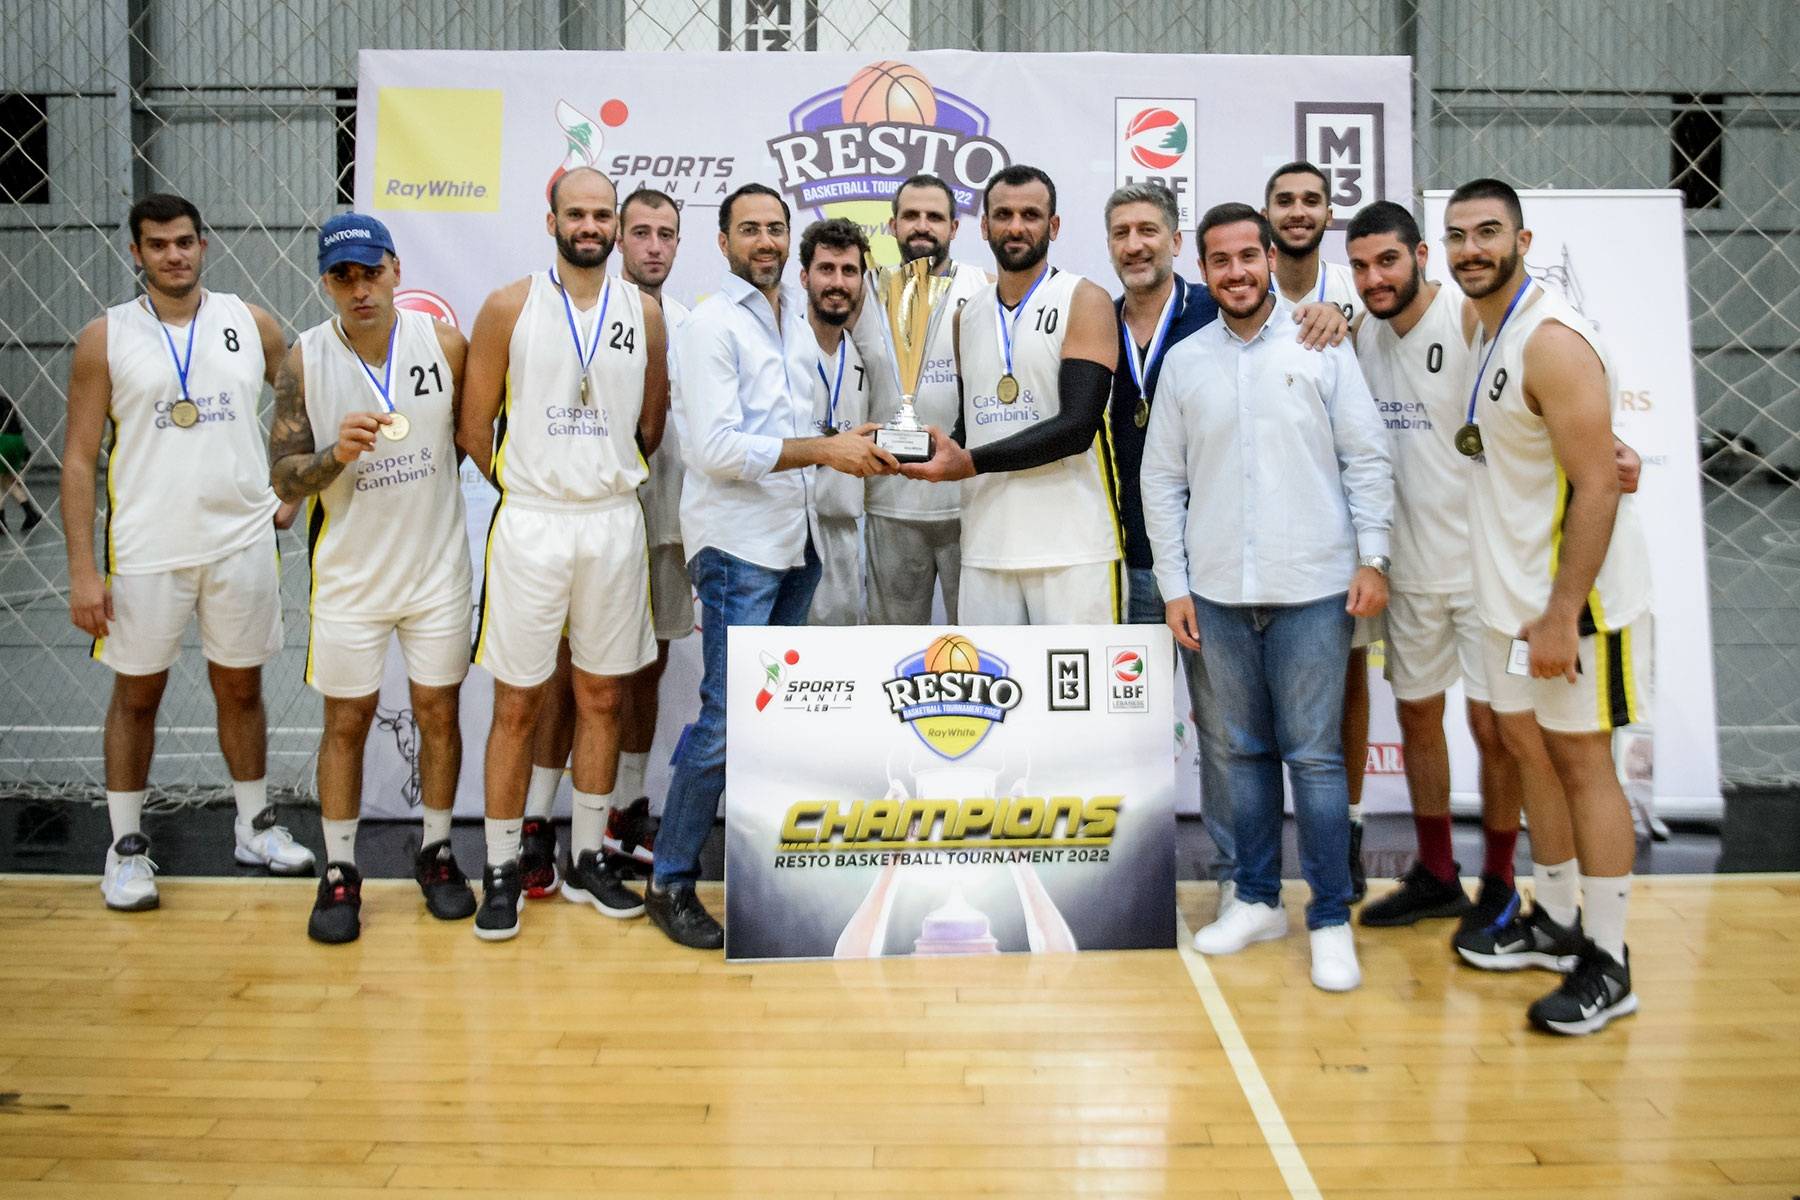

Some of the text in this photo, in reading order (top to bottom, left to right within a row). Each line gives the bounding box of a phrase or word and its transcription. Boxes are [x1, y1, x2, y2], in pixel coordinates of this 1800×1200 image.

[1318, 126, 1361, 165] M
[609, 154, 735, 178] SPORTS
[772, 125, 1006, 190] RESTO
[385, 179, 486, 200] RayWhite
[612, 180, 728, 194] ANIA
[802, 180, 870, 202] BASKETBALL
[324, 228, 371, 247] SANTORINI
[1034, 305, 1059, 334] 10
[224, 328, 240, 352] 8
[610, 320, 635, 354] 24
[926, 359, 952, 372] per
[1426, 342, 1444, 373] 0
[409, 362, 443, 396] 21
[854, 365, 865, 391] 7
[1488, 367, 1508, 402] 9
[154, 391, 231, 414] Caer &
[1022, 389, 1034, 403] &
[546, 405, 600, 422] Casper
[975, 405, 1040, 425] Gambini's
[420, 447, 432, 461] &
[355, 463, 437, 492] Gambini's
[1058, 660, 1079, 680] M
[787, 680, 856, 693] SPORTS
[883, 671, 1022, 711] RESTO
[1112, 685, 1144, 699] LBF
[783, 694, 853, 702] MANIA
[806, 704, 829, 712] LEB
[903, 704, 1001, 717] BASKETBALL TOURNAMENT 2022
[928, 728, 976, 738] RayWhite
[779, 795, 1126, 843] CHAMPIONS
[774, 850, 1110, 869] RESTO BASKETBALL TOURNAMENT 2022
